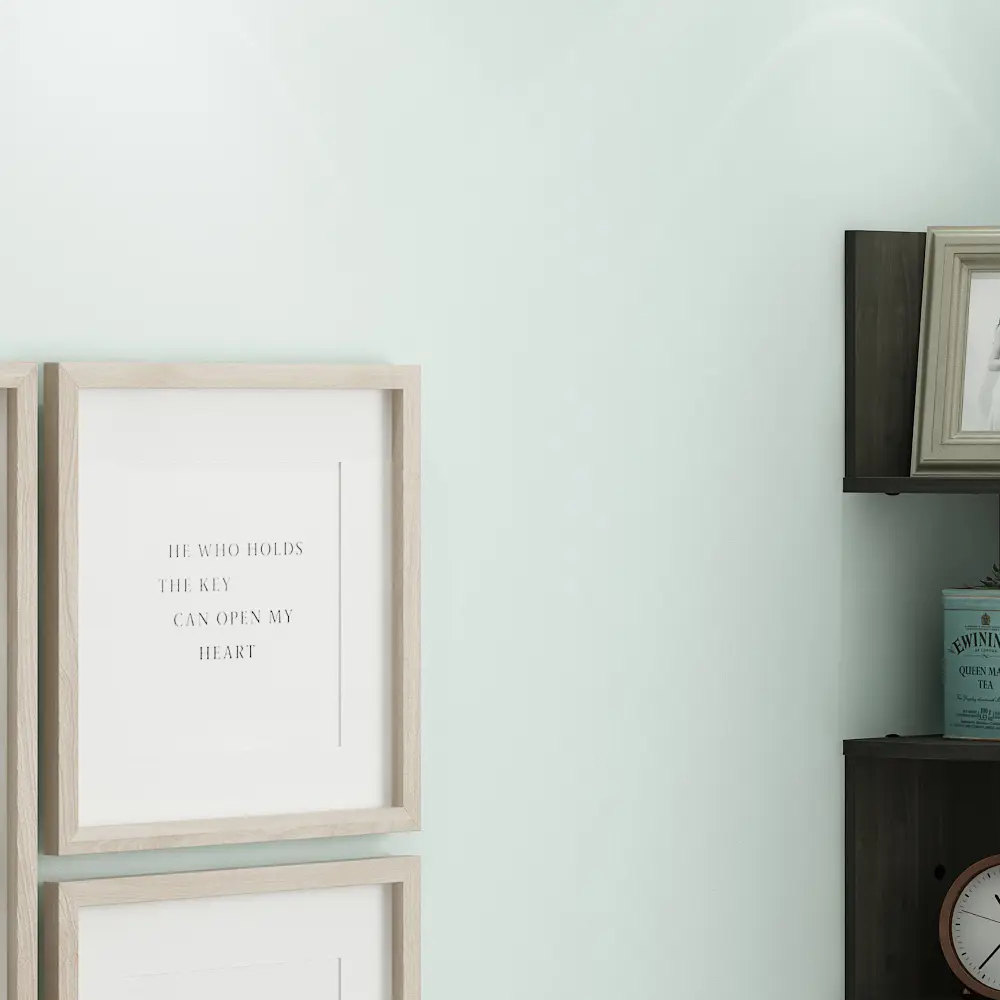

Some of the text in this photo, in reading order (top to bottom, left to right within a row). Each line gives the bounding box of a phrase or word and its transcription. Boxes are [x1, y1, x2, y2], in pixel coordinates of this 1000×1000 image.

[168, 541, 303, 558] HE WHO HOLDS
[158, 576, 231, 593] THE KEY
[173, 608, 293, 627] CAN OPEN MY
[199, 644, 256, 660] HEART
[958, 665, 986, 678] QUEEN
[977, 679, 994, 690] TEA
